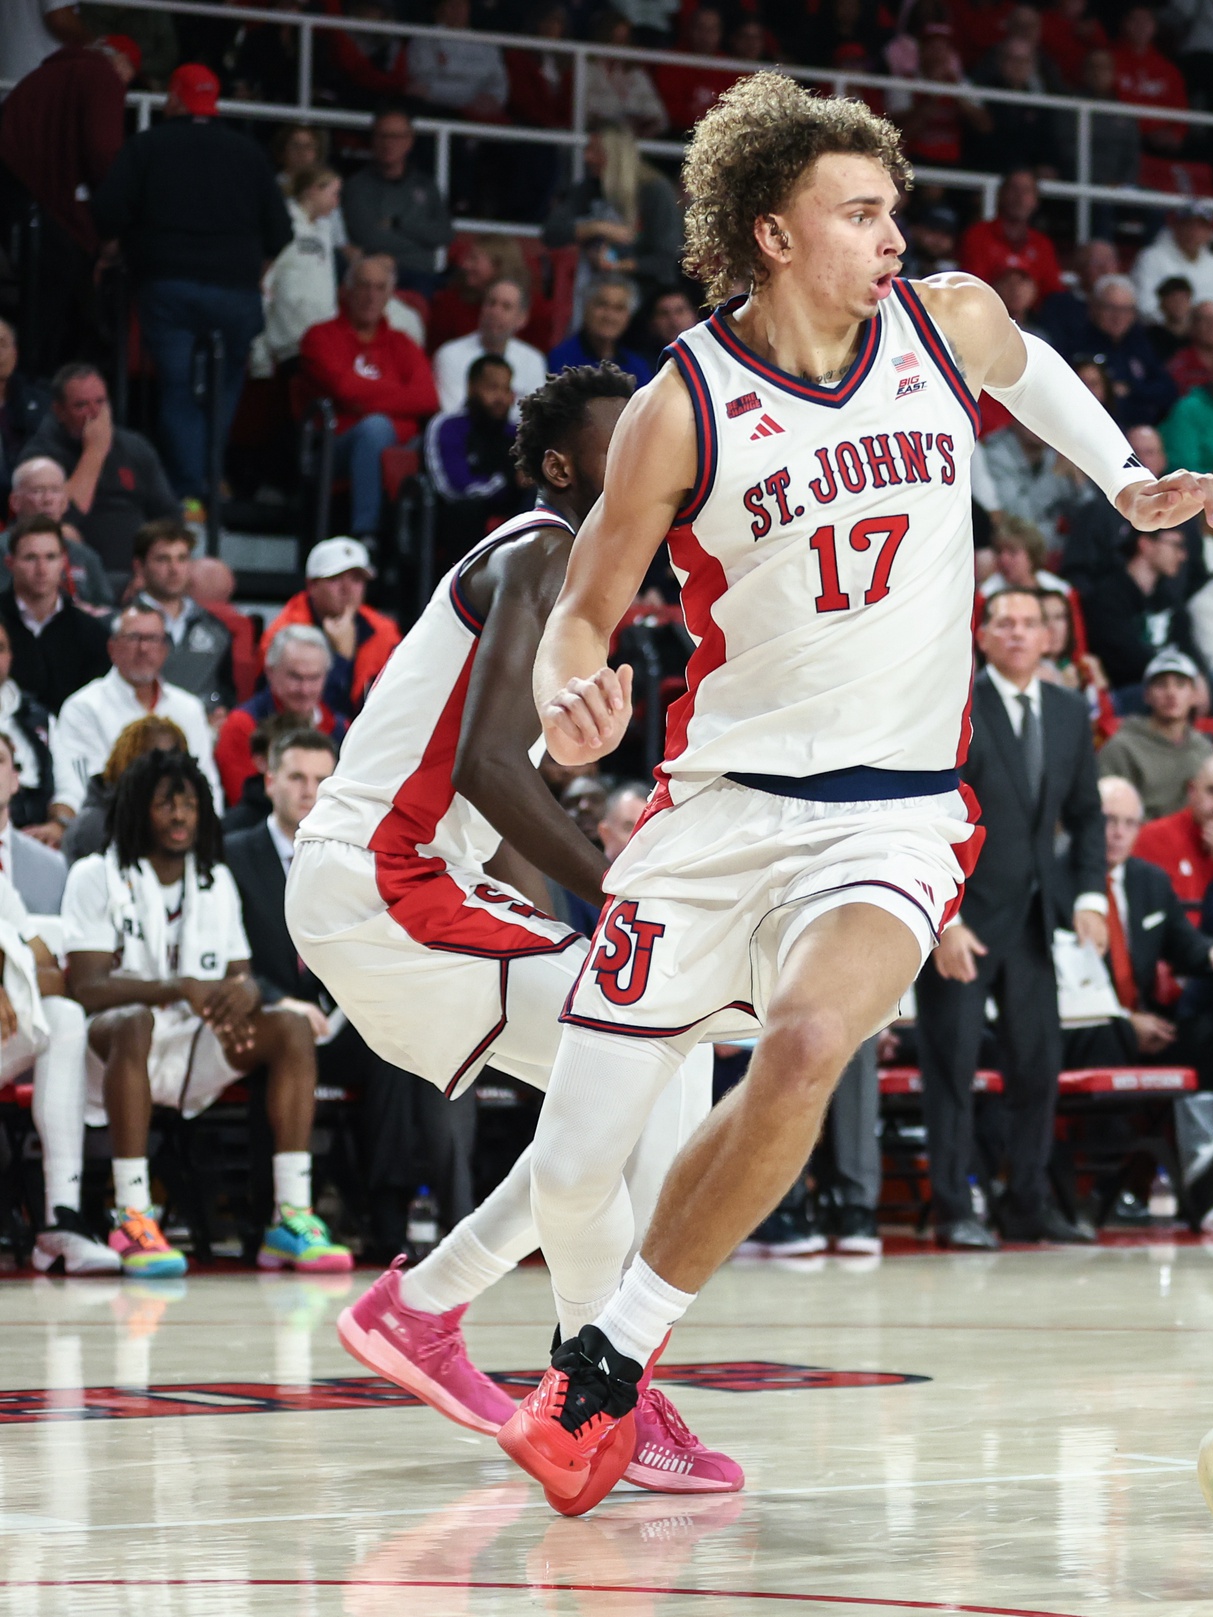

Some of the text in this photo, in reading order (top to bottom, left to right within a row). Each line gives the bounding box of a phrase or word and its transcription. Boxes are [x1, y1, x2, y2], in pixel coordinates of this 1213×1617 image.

[897, 381, 927, 395] EAST
[899, 375, 920, 387] BIG
[727, 399, 762, 418] CHANGE
[740, 393, 757, 405] THE
[743, 430, 956, 542] ST. JOHN'S
[809, 514, 909, 613] 17
[638, 1449, 694, 1476] ADVISORY
